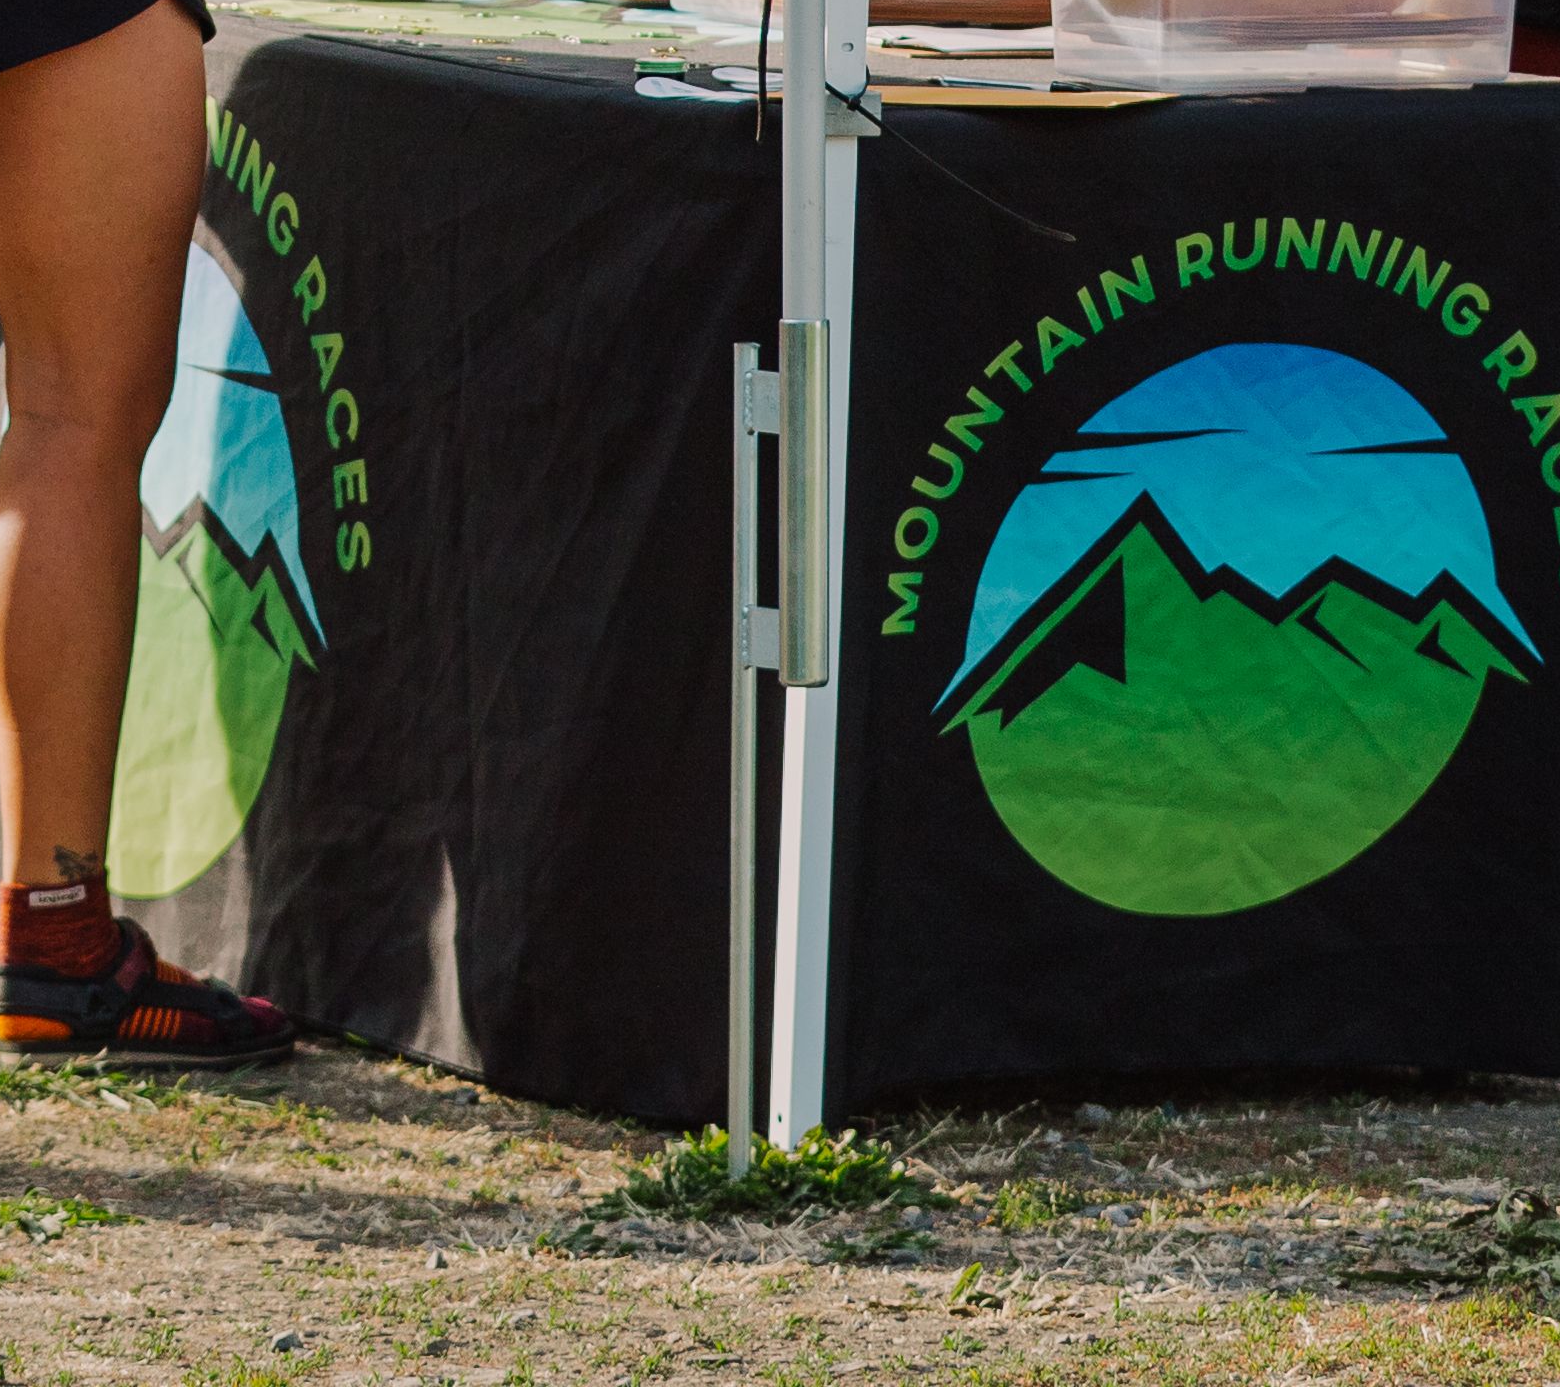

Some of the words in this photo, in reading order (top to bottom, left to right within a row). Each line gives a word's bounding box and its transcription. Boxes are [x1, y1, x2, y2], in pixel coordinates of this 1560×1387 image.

[205, 94, 301, 255] NING
[293, 254, 373, 574] RACES
[881, 254, 1158, 636] MOUNTAIN
[1175, 217, 1491, 338] RUNNING
